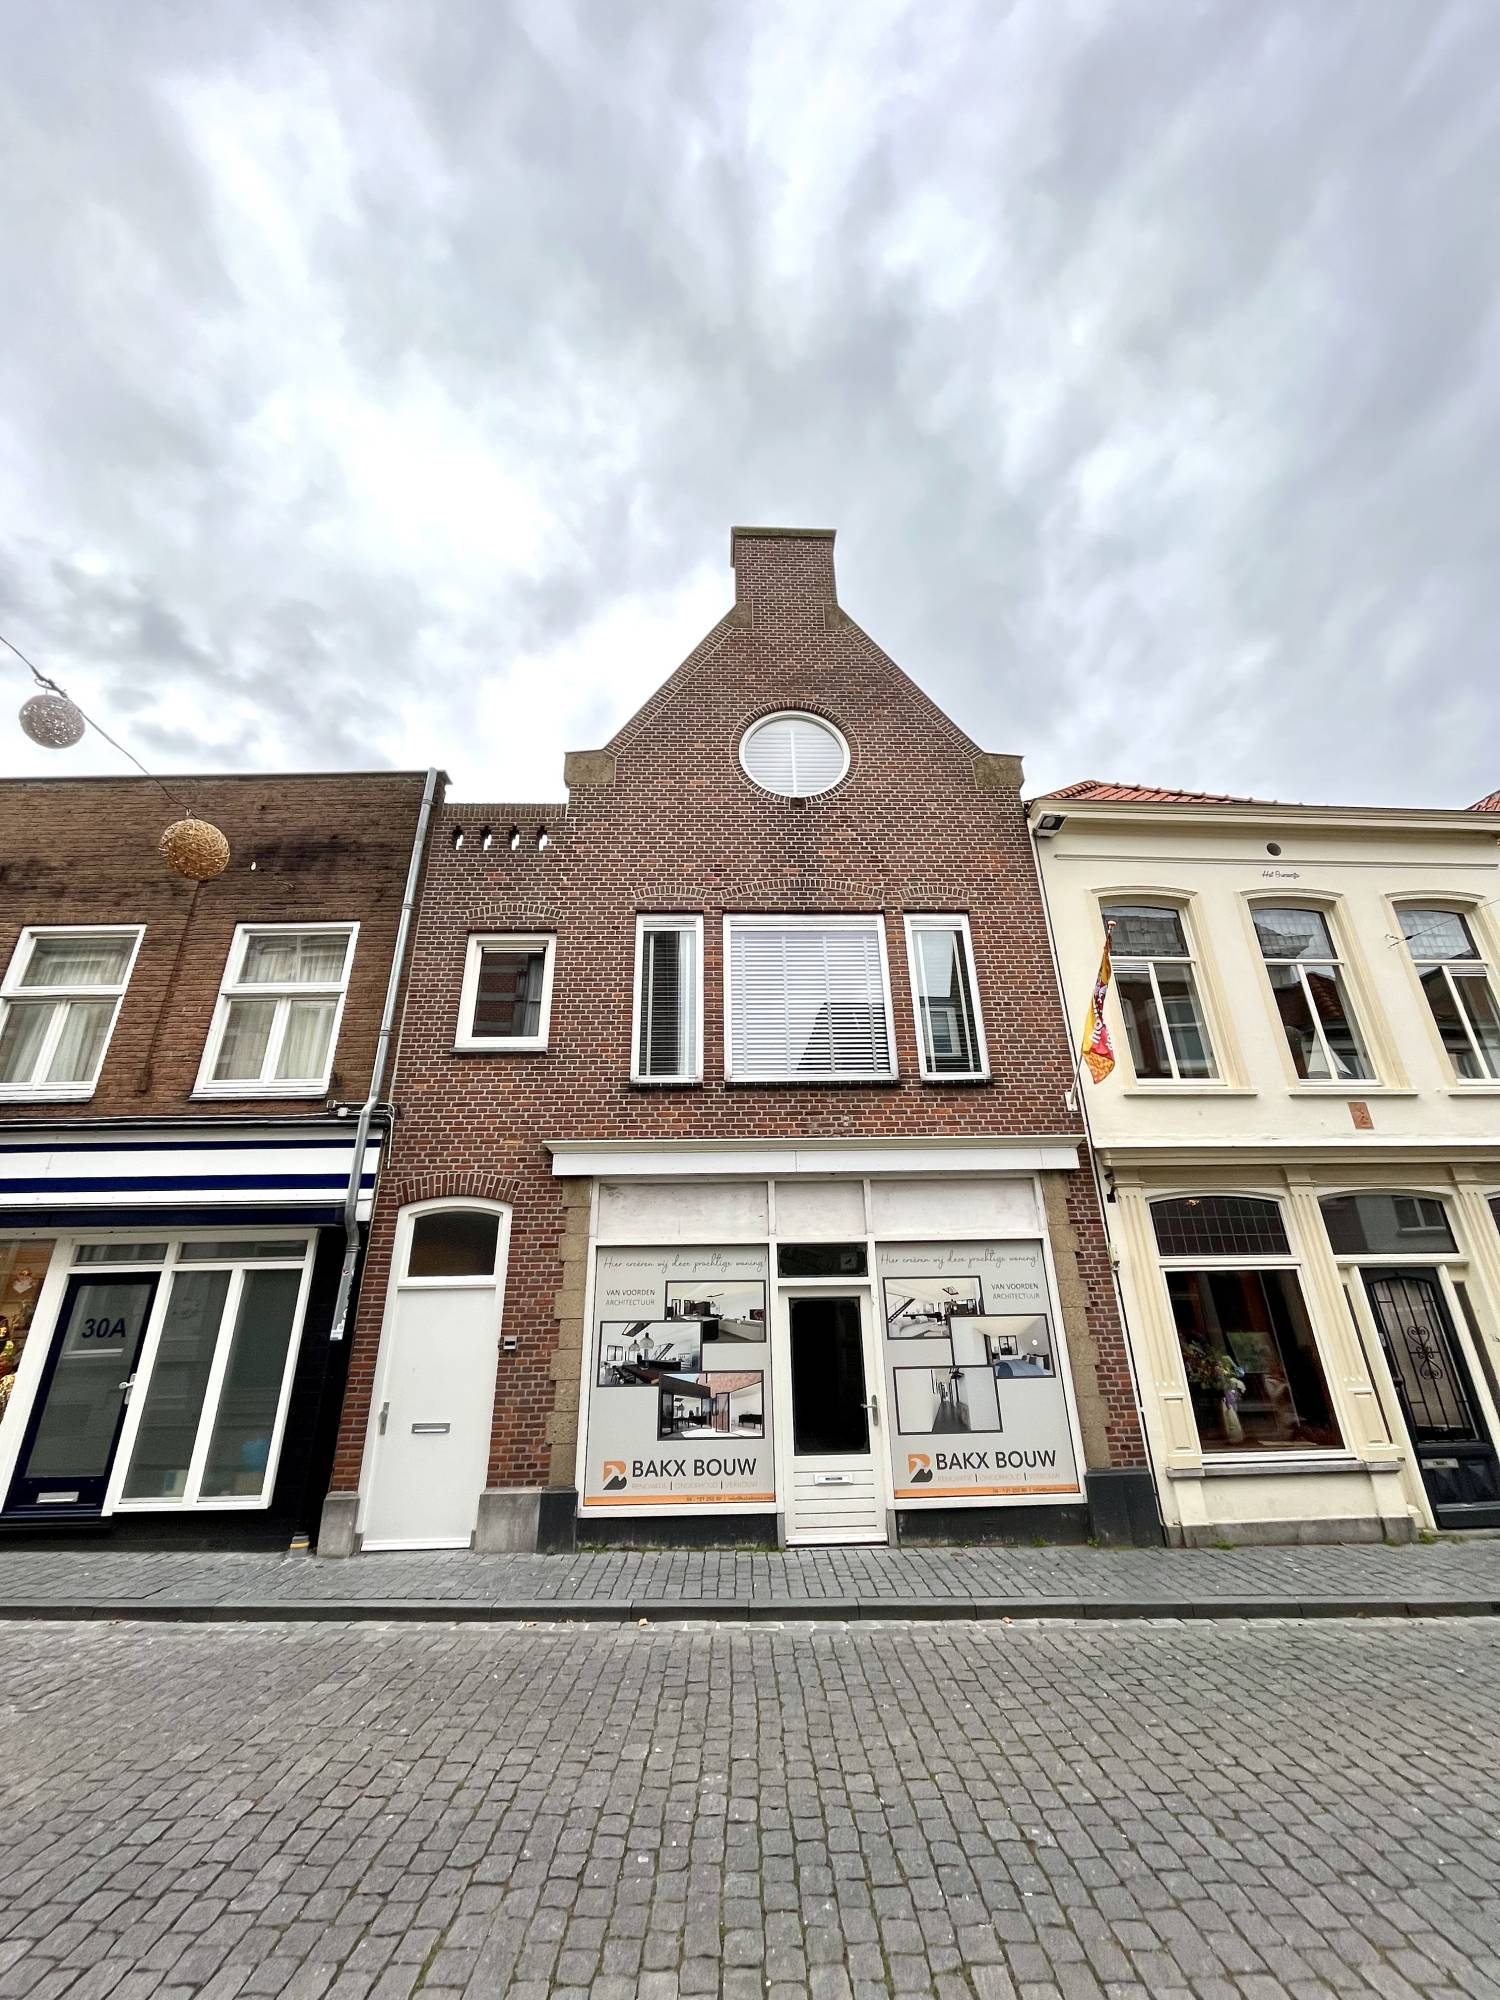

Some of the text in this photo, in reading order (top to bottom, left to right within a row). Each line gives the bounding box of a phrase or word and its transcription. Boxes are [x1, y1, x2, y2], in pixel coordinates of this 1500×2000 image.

[603, 1255, 623, 1269] Hier
[622, 1288, 656, 1296] VOORDEN
[1006, 1282, 1039, 1290] VOORDEN
[992, 1292, 1040, 1300] ARCHITECTUUR
[81, 1317, 127, 1338] 30A
[935, 1449, 1057, 1470] BAKX BOUW
[632, 1457, 757, 1478] BAKX BOUW
